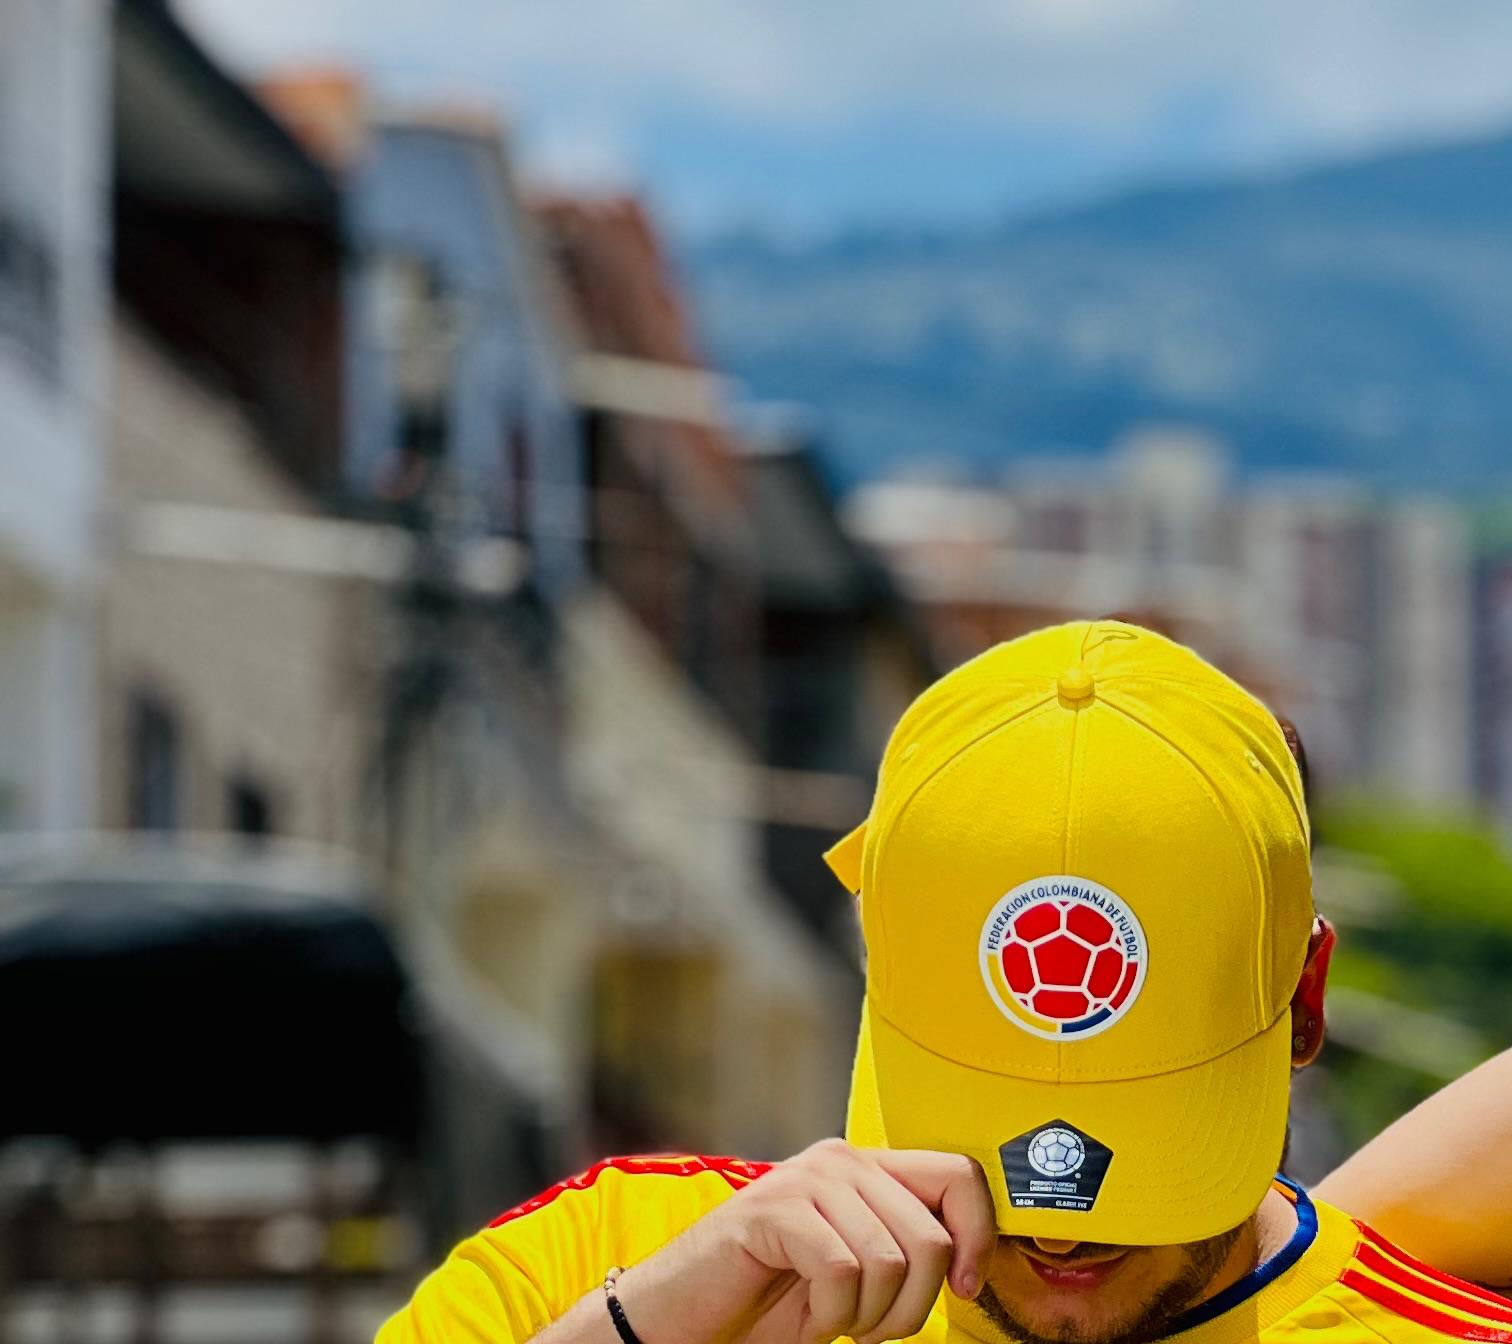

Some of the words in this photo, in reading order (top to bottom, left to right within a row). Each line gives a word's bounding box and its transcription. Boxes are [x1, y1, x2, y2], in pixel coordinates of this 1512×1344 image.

[1031, 884, 1105, 909] COLOMBIANA
[1105, 903, 1120, 919] DE
[1115, 915, 1138, 958] FUTBOL
